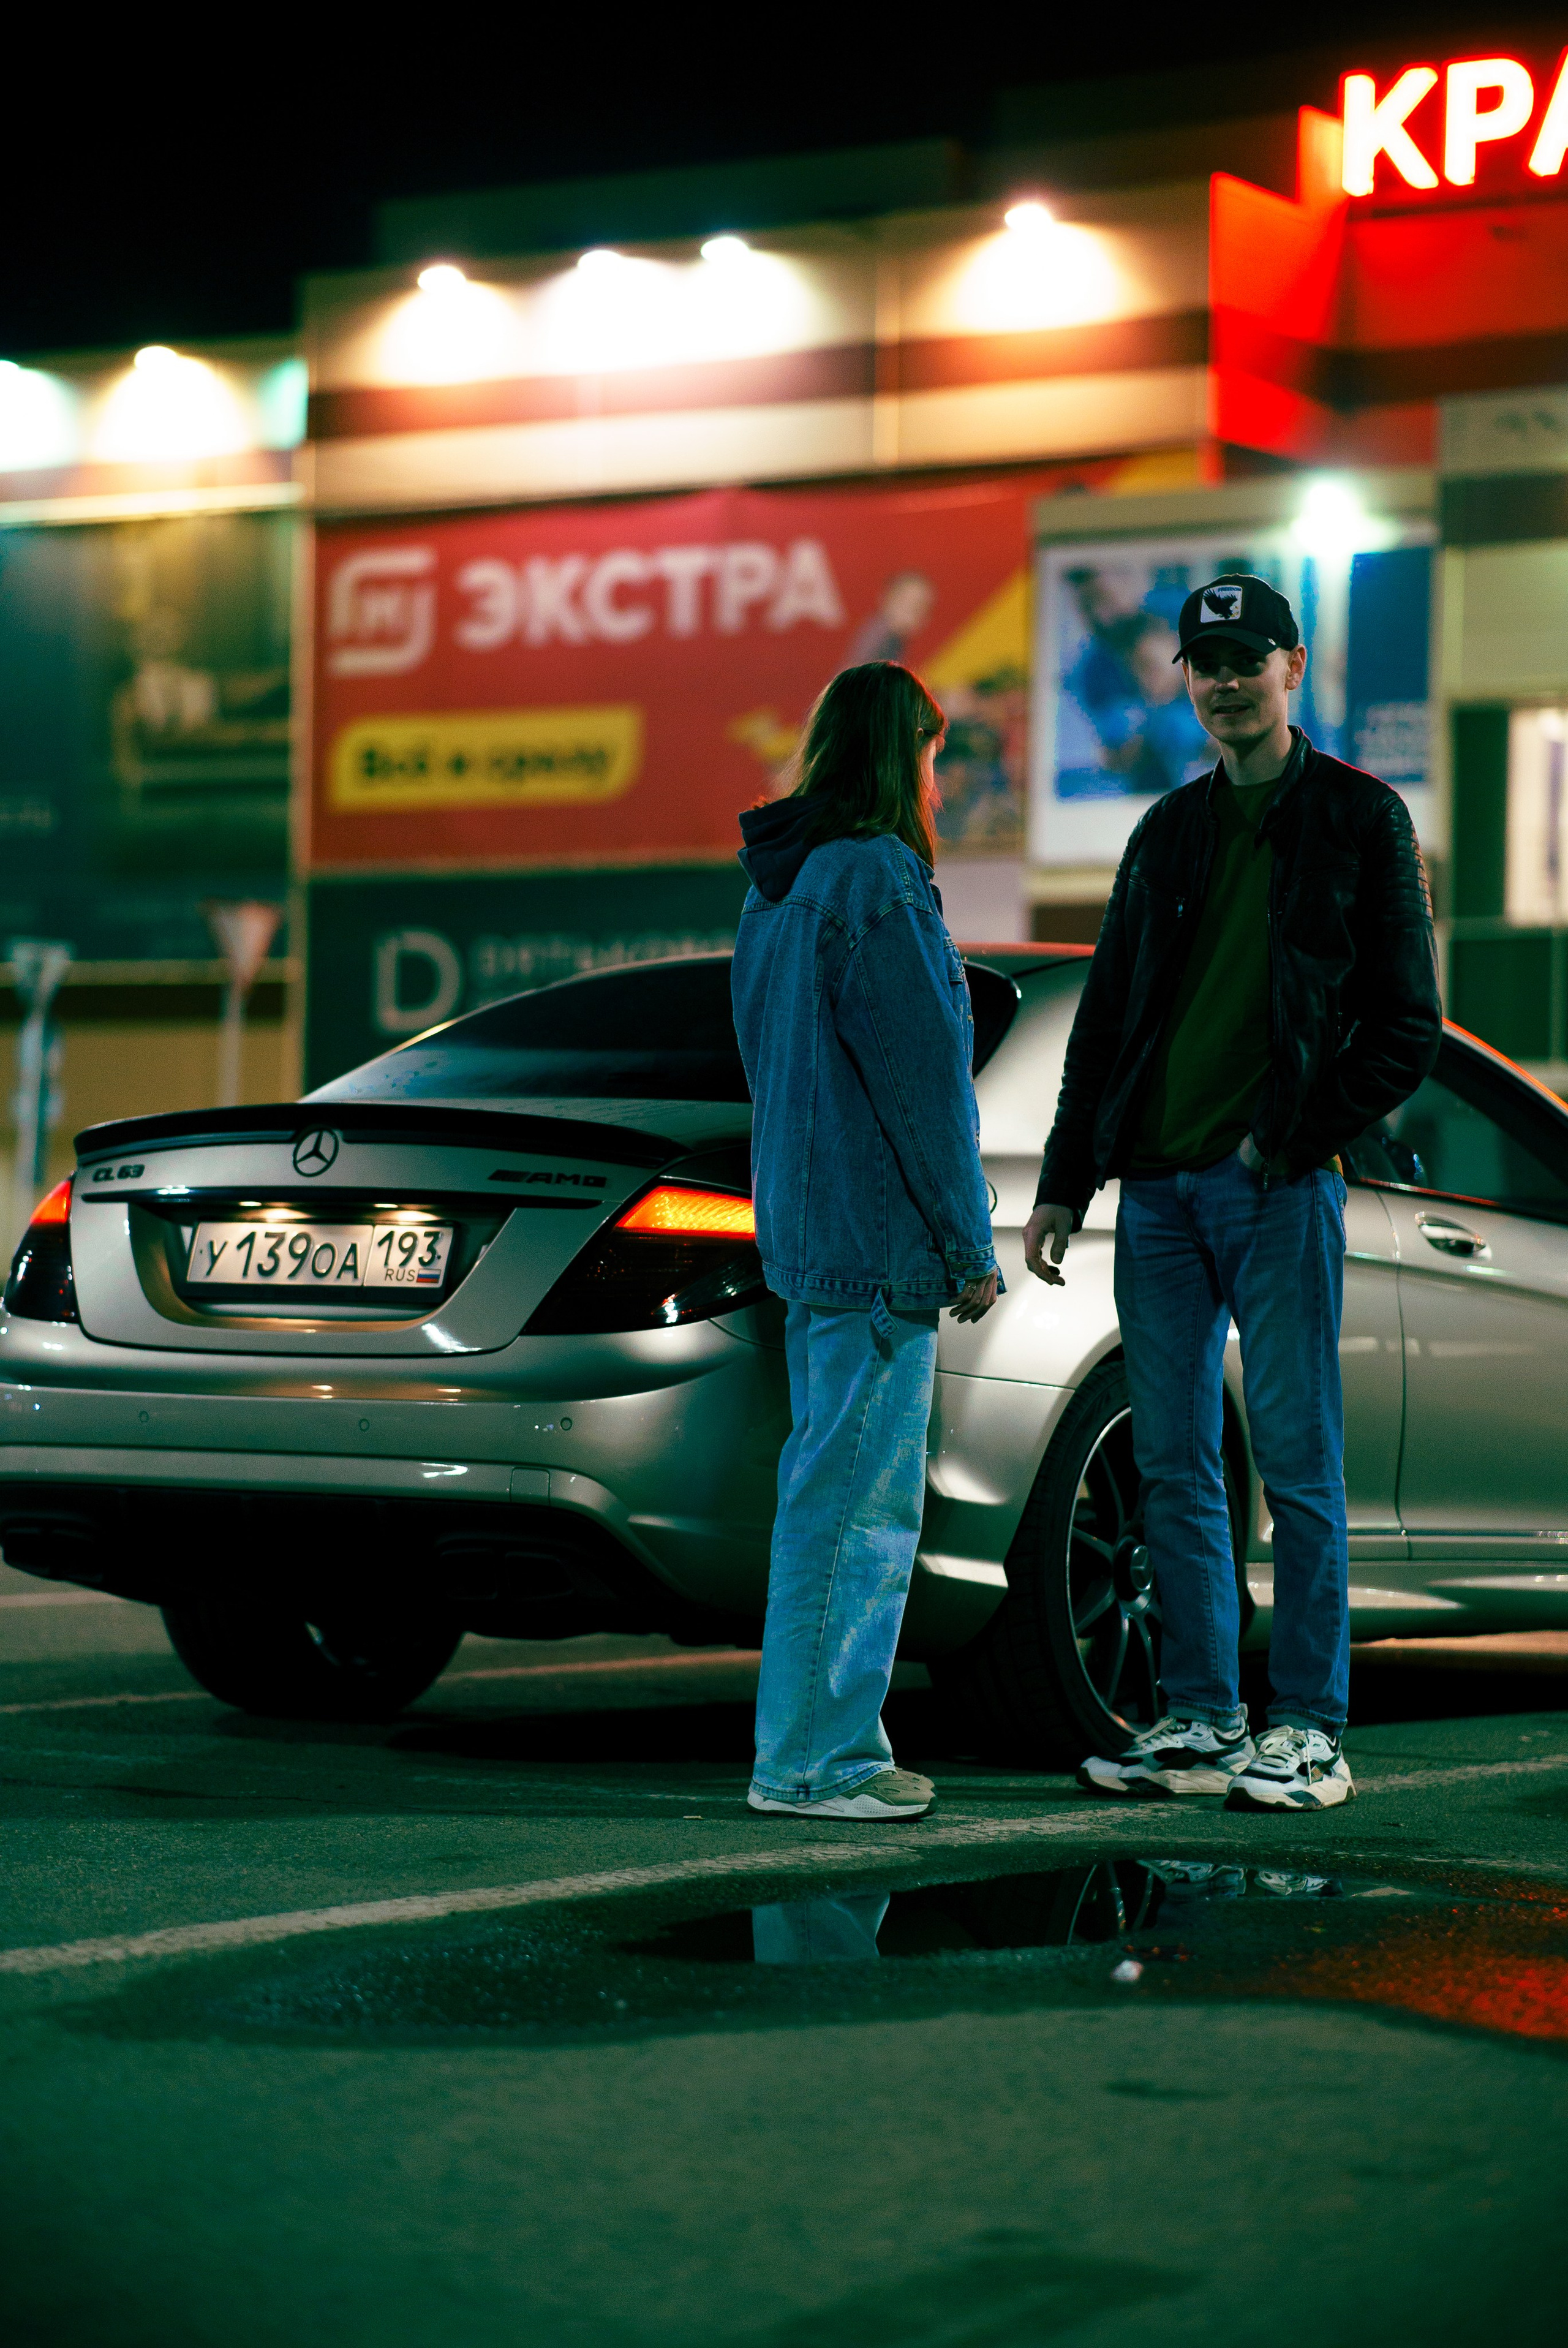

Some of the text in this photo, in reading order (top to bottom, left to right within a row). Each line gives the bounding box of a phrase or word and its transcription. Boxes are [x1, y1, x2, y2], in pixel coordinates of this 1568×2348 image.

[455, 537, 843, 650] ЭКСТРА
[377, 1230, 442, 1267] 193
[384, 1268, 416, 1282] RUS
